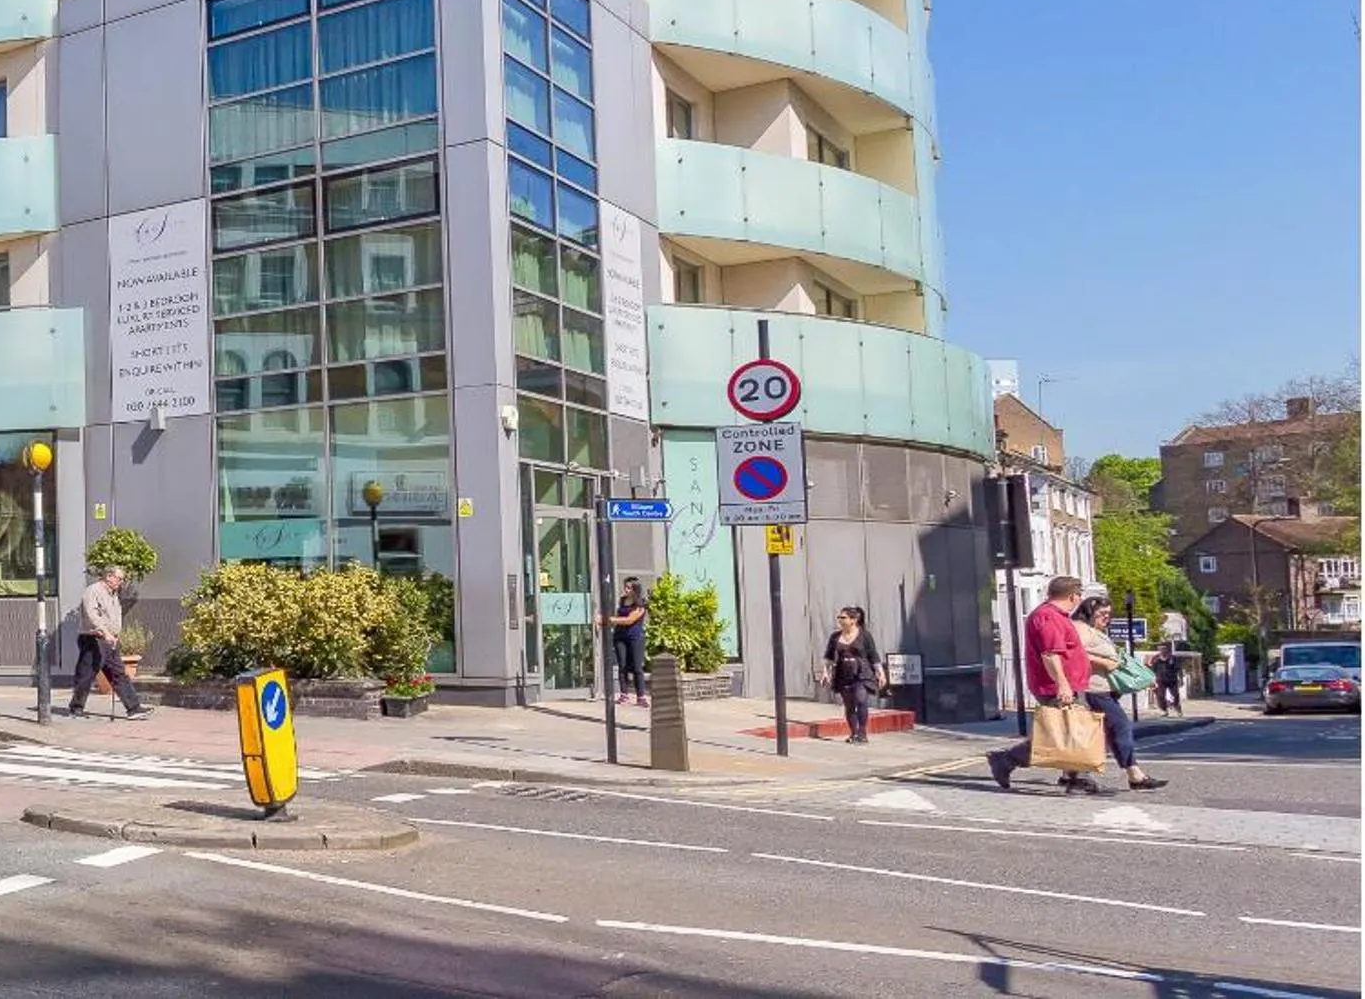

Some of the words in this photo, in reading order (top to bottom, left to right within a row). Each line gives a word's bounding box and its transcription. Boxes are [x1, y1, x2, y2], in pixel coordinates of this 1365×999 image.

[116, 278, 144, 290] NOW
[145, 266, 199, 283] AVAILABLE
[149, 291, 199, 308] BEDROOM
[116, 311, 153, 325] LUXURY
[156, 304, 201, 319] SERVICED
[128, 316, 190, 336] APARTMENTS
[130, 345, 163, 359] SHORT
[119, 362, 162, 378] ENQUIRE
[163, 359, 203, 373] WITHIN
[739, 375, 787, 403] 20
[171, 396, 196, 409] 2100
[722, 426, 795, 440] Controlled
[733, 438, 785, 454] ZONE
[688, 457, 708, 584] SANCTU
